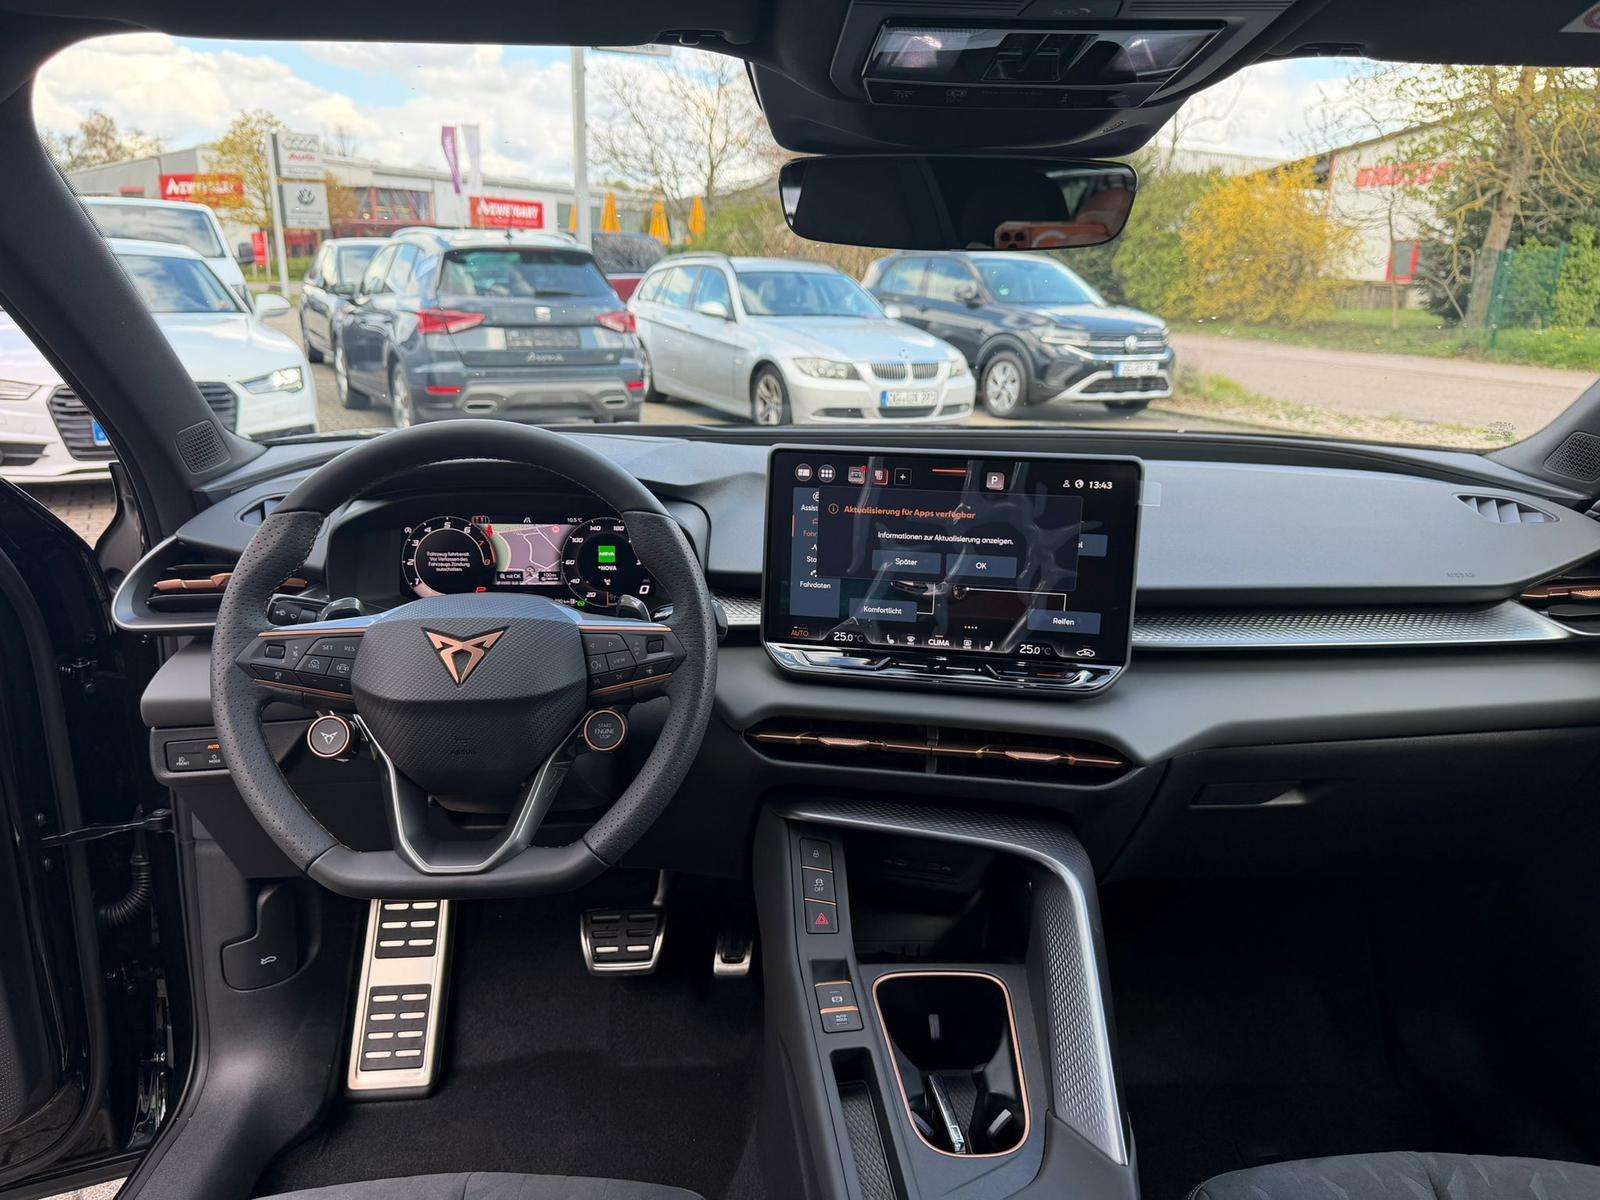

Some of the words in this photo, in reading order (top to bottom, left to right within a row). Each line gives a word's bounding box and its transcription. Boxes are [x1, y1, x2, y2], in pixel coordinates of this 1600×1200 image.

[1088, 480, 1113, 490] 13:43
[844, 505, 901, 517] Aktualisierung
[901, 507, 913, 517] für
[914, 509, 935, 519] Apps
[935, 510, 976, 520] verfügbar
[444, 521, 451, 529] 5
[411, 539, 420, 547] 3
[877, 531, 923, 541] Informationen
[934, 533, 981, 545] Aktualisierung
[981, 537, 1014, 546] anzeigen.
[895, 557, 918, 566] Später
[975, 562, 987, 570] OK
[639, 585, 650, 595] 0
[800, 581, 831, 590] Fahrdaten
[863, 605, 902, 615] Komfortlicht
[1052, 617, 1075, 626] Reifen
[791, 629, 809, 638] AUTO
[928, 638, 949, 647] CLIMA
